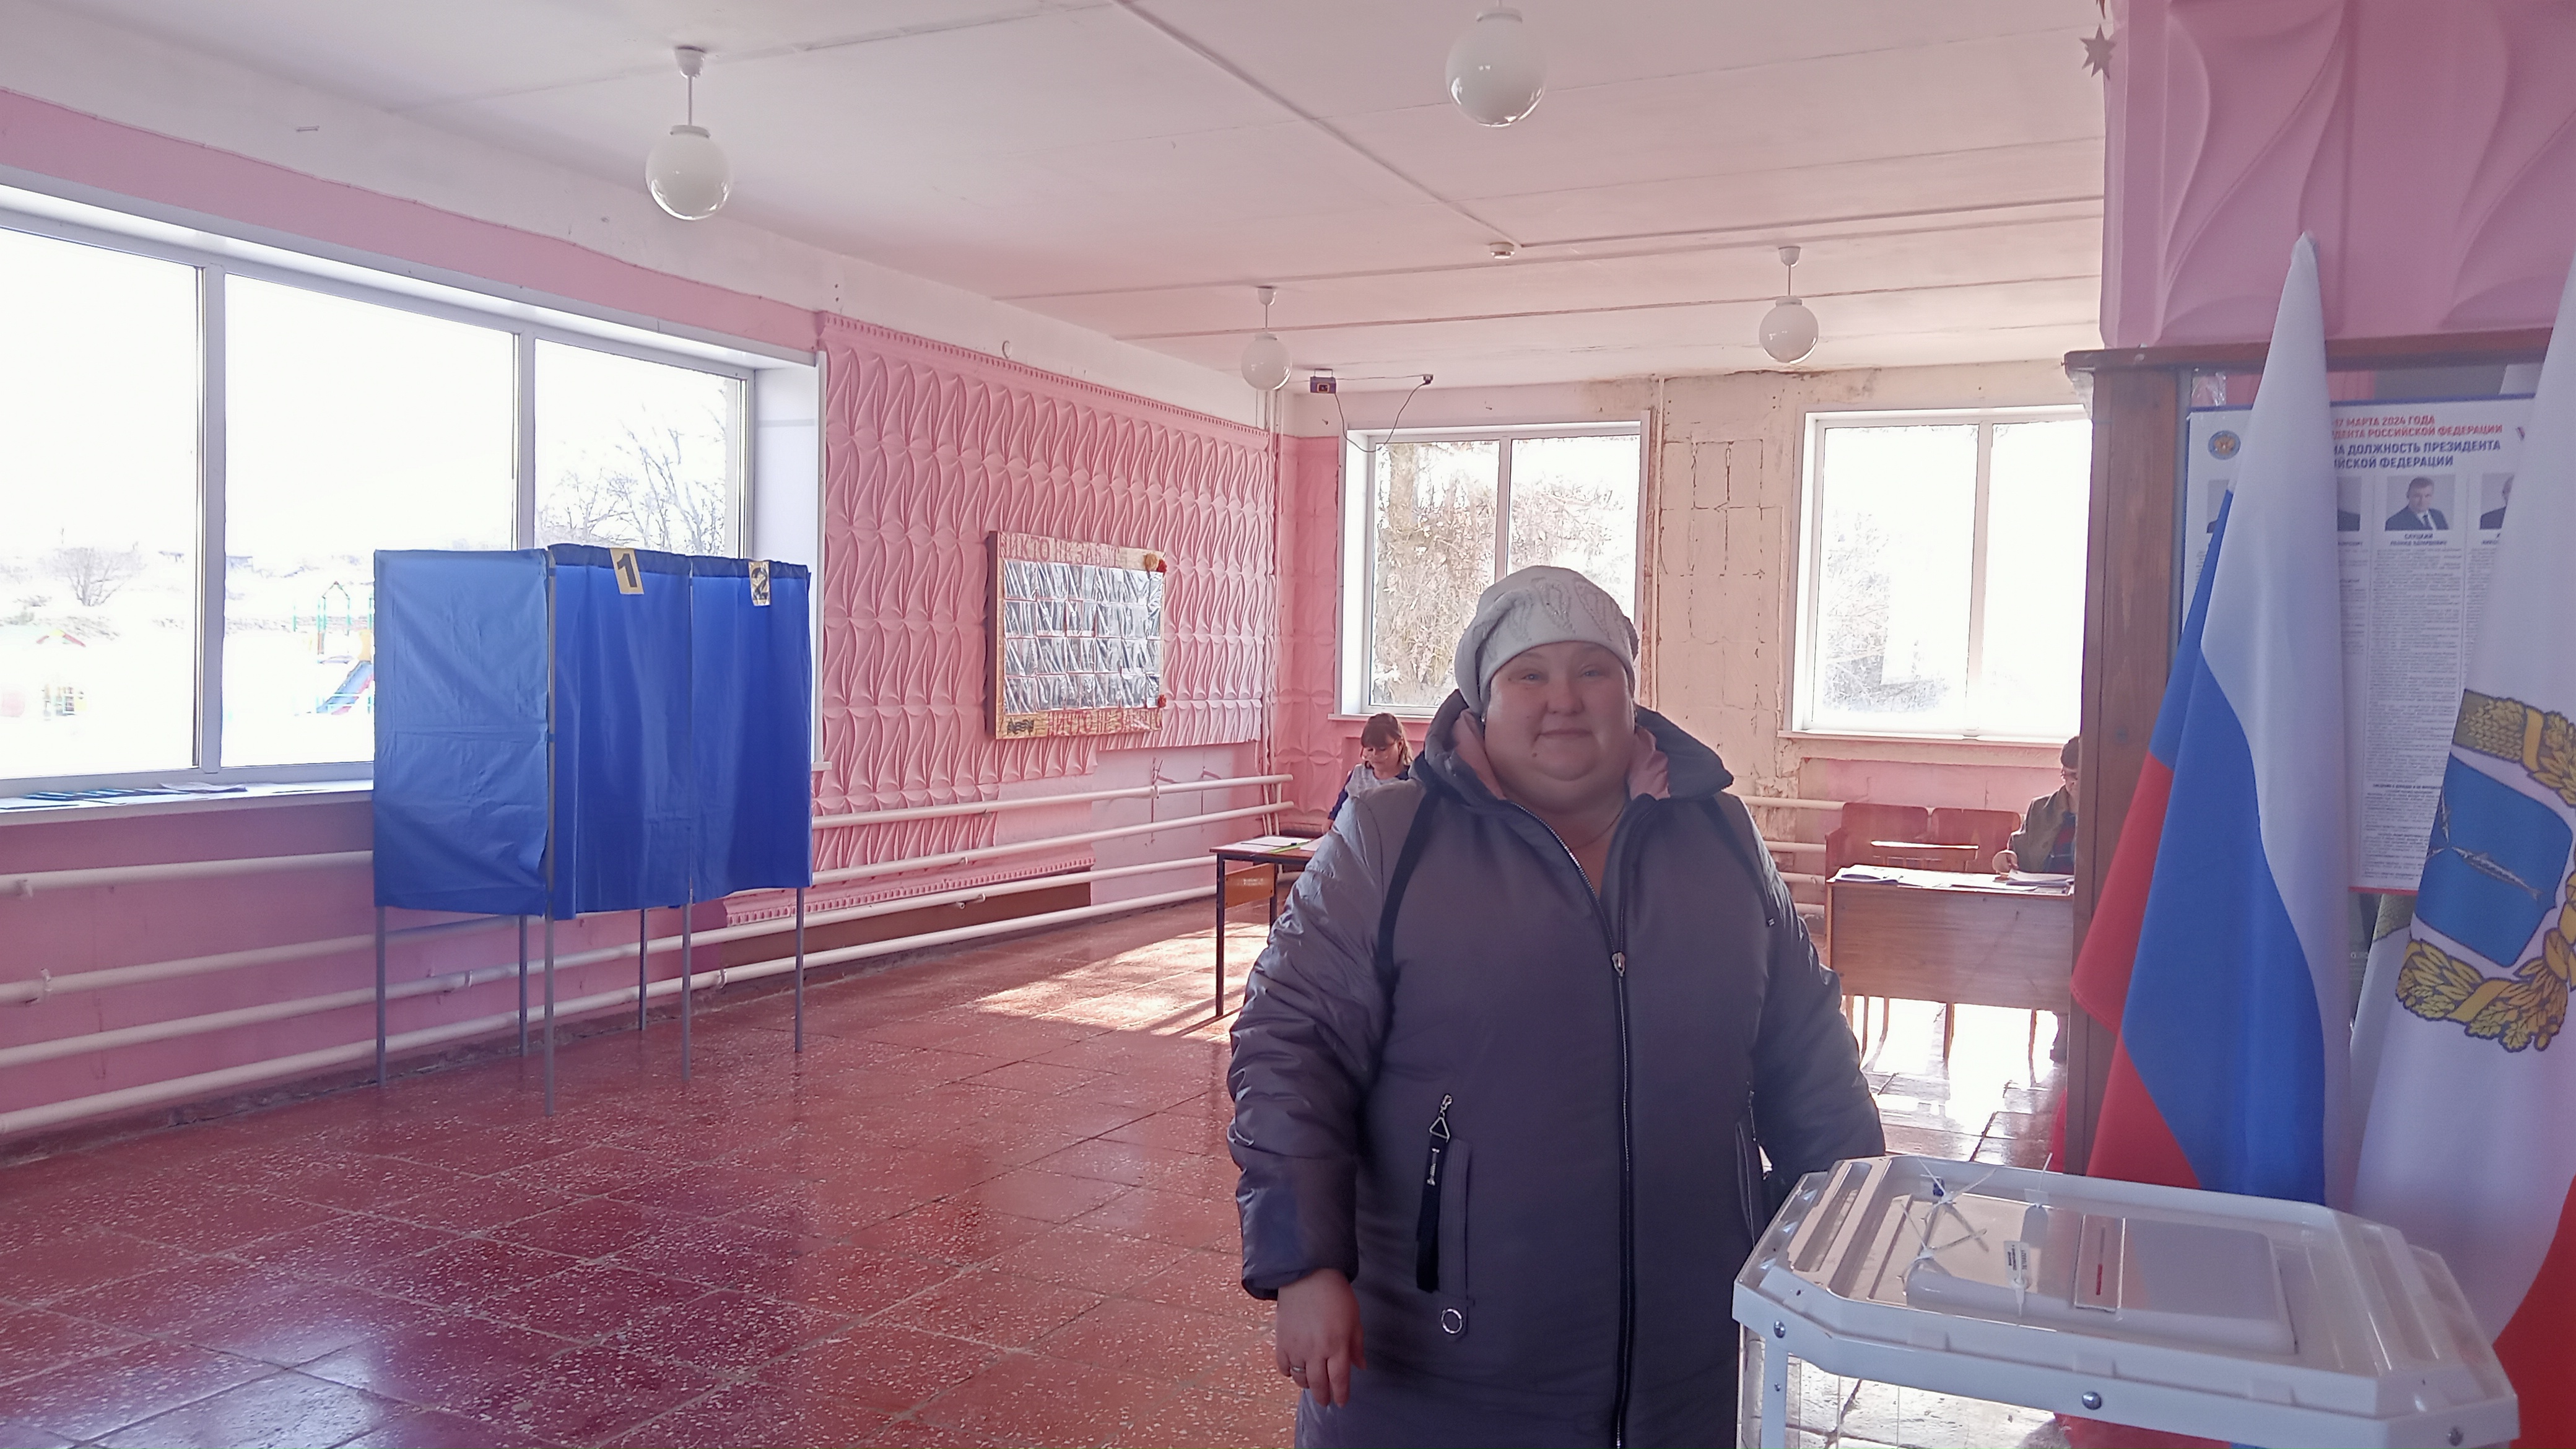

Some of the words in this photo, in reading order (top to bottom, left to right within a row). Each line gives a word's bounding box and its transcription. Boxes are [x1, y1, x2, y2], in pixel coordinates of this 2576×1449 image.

[2347, 417, 2380, 427] МАРТА
[2382, 416, 2406, 425] 2024
[2408, 416, 2435, 425] ГОДА
[2332, 428, 2365, 440] ДЕНТА
[2368, 426, 2435, 438] РОССИЙСКОЙ
[2437, 424, 2503, 437] ФЕДЕРАЦИИ
[2348, 442, 2421, 456] ДОЛЖНОСТЬ
[2424, 440, 2501, 453] ПРЕЗИДЕНТА
[2380, 455, 2454, 469] ФЕДЕРАЦИИ
[617, 553, 637, 588] 1
[751, 567, 768, 601] 2
